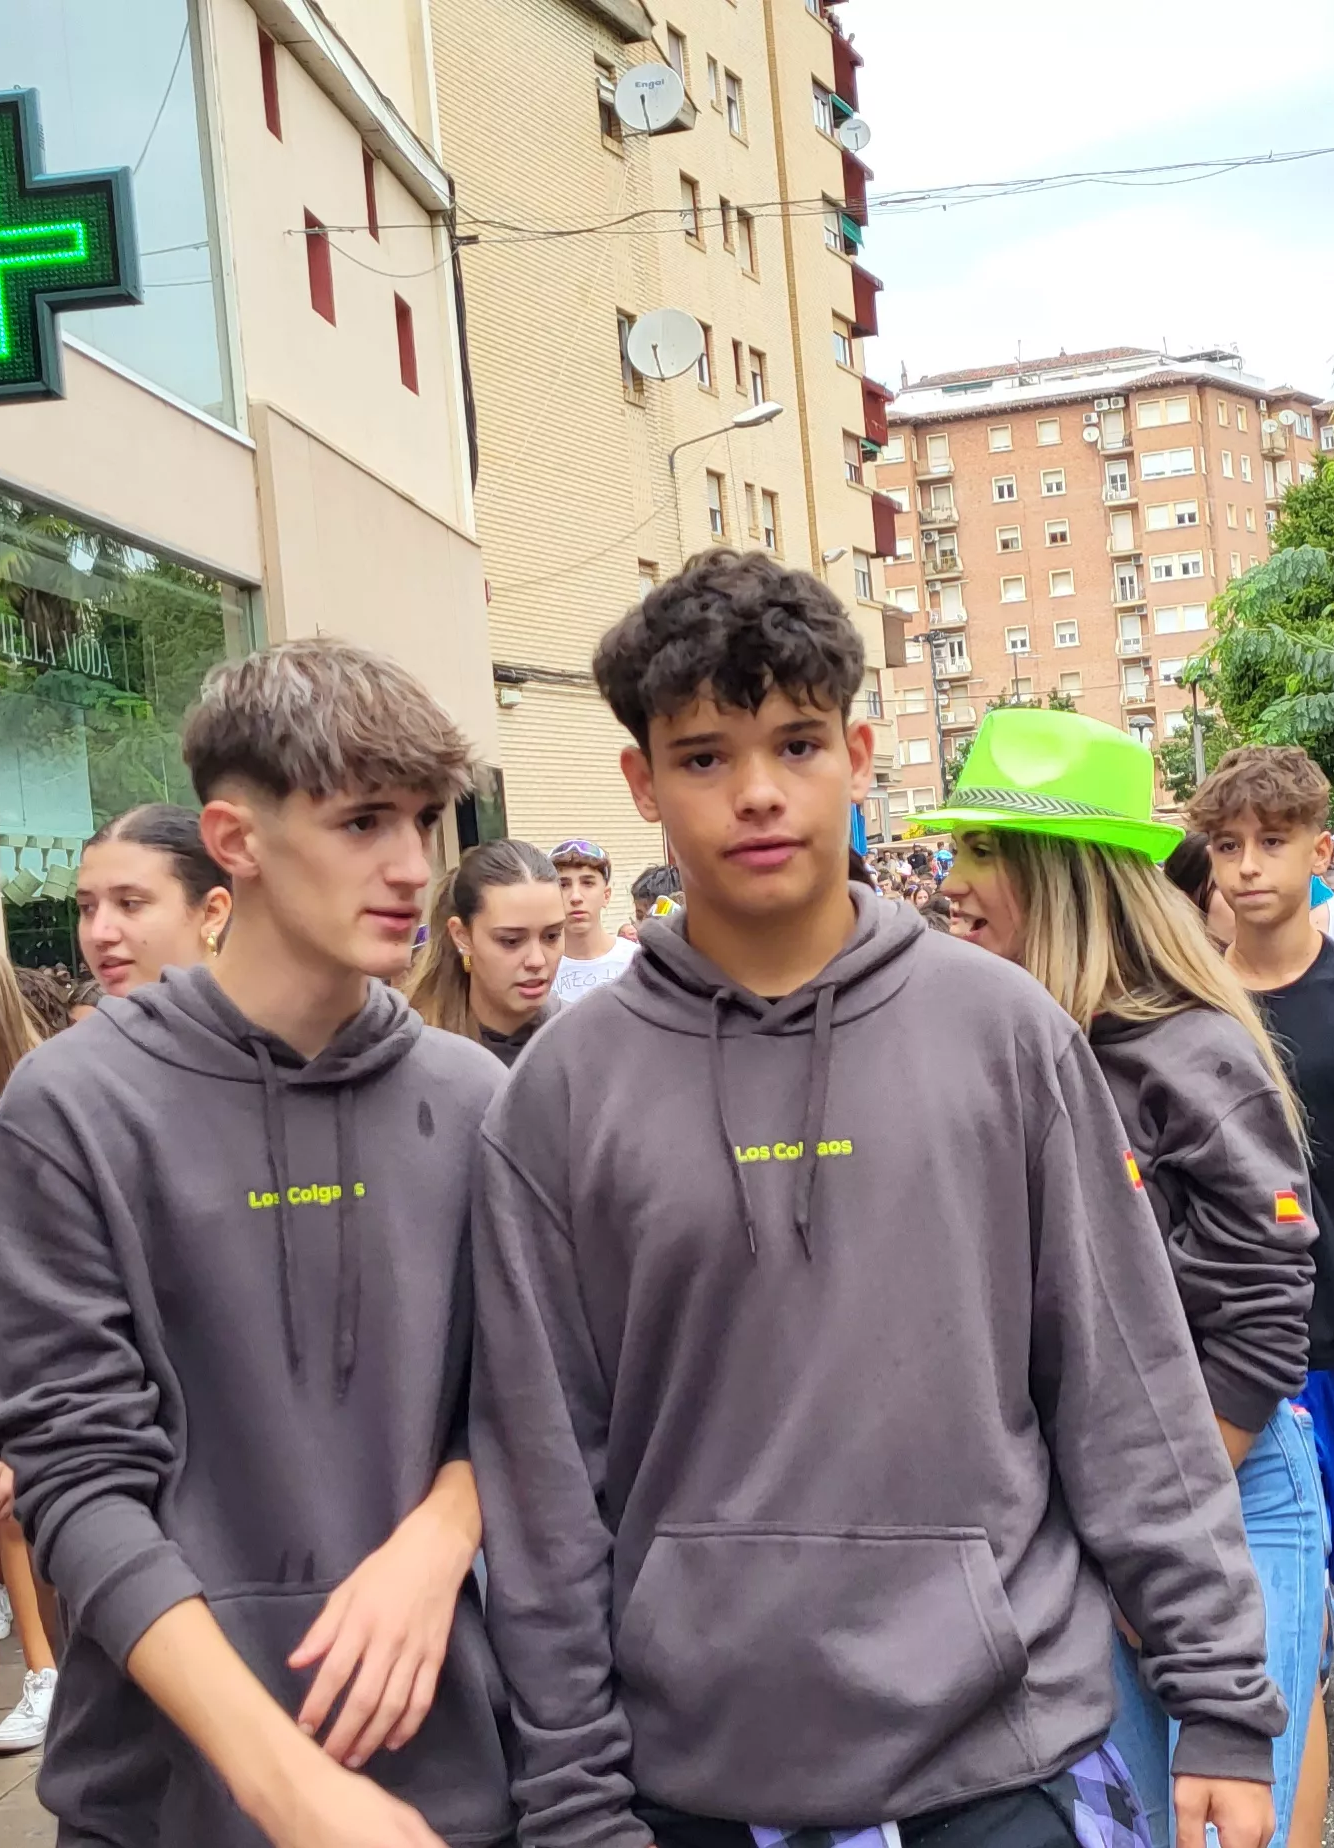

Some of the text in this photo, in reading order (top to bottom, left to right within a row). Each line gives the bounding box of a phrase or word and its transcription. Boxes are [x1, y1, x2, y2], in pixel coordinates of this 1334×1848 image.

[734, 1140, 853, 1164] Los Colaos
[287, 1183, 365, 1206] Colgas
